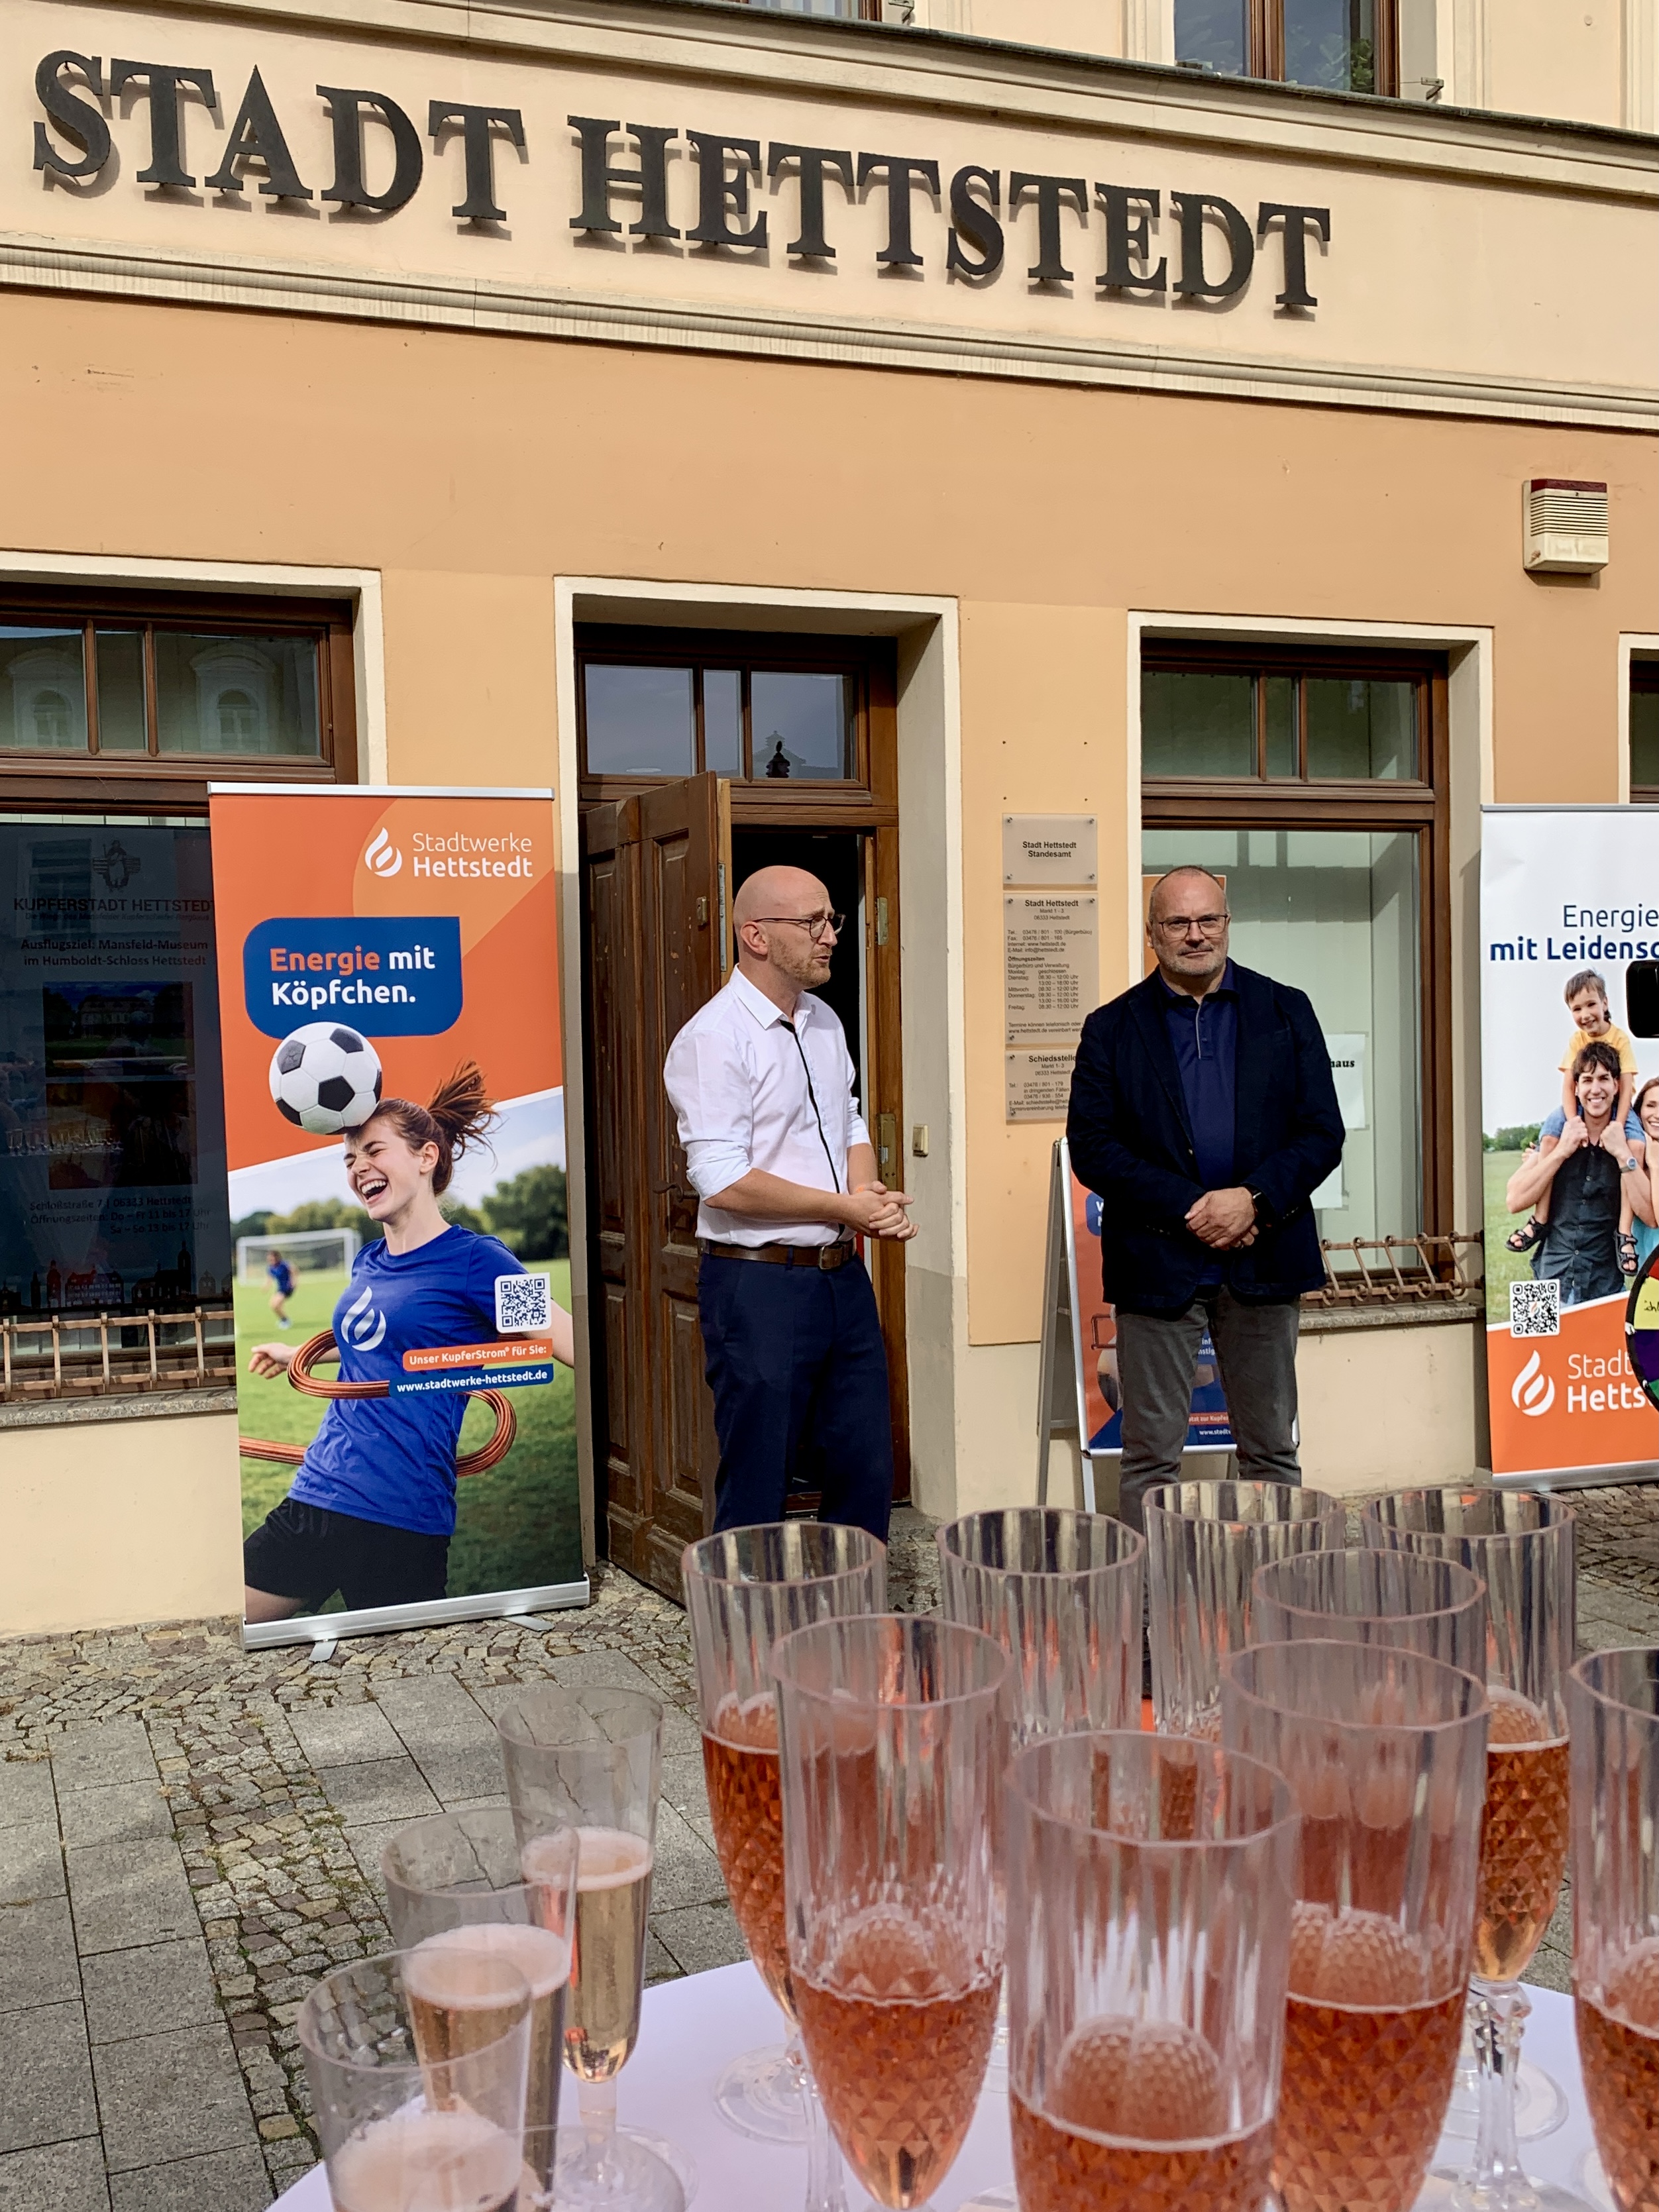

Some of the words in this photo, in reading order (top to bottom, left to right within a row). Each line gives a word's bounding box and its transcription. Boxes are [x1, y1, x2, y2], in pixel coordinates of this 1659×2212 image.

[33, 50, 526, 221] STADT
[568, 115, 1330, 307] HETTSTEDT
[413, 832, 532, 853] Stadtwerke
[413, 855, 533, 878] Hettstedt
[14, 898, 127, 911] KUPFERSTADT
[1564, 903, 1659, 933] Energie
[21, 938, 95, 951] Ausflugsziel:
[99, 939, 208, 949] Mansfeld-Museum
[1490, 935, 1538, 961] mit
[24, 955, 39, 965] im
[43, 955, 149, 965] Humboldt-Schloss
[152, 955, 207, 965] Hettstedt
[270, 945, 380, 976] Energie
[388, 945, 435, 970] mit
[272, 979, 416, 1010] Köpfchen.
[30, 1199, 94, 1210] Schloßstraße
[146, 1196, 191, 1206] Hettstedt
[111, 1212, 124, 1220] Do
[162, 1210, 177, 1218] bis
[179, 1209, 191, 1218] 17
[110, 1225, 122, 1234] Sa
[133, 1224, 144, 1233] So
[148, 1223, 159, 1232] 13
[162, 1222, 176, 1232] bis
[179, 1222, 189, 1231] 17
[193, 1222, 209, 1230] Uhr
[409, 1354, 439, 1365] Unser
[511, 1345, 527, 1356] für
[529, 1344, 547, 1355] Sie:
[397, 1369, 548, 1393] www.stadtwerke-hettstedt.de
[1568, 1382, 1652, 1413] Hetts
